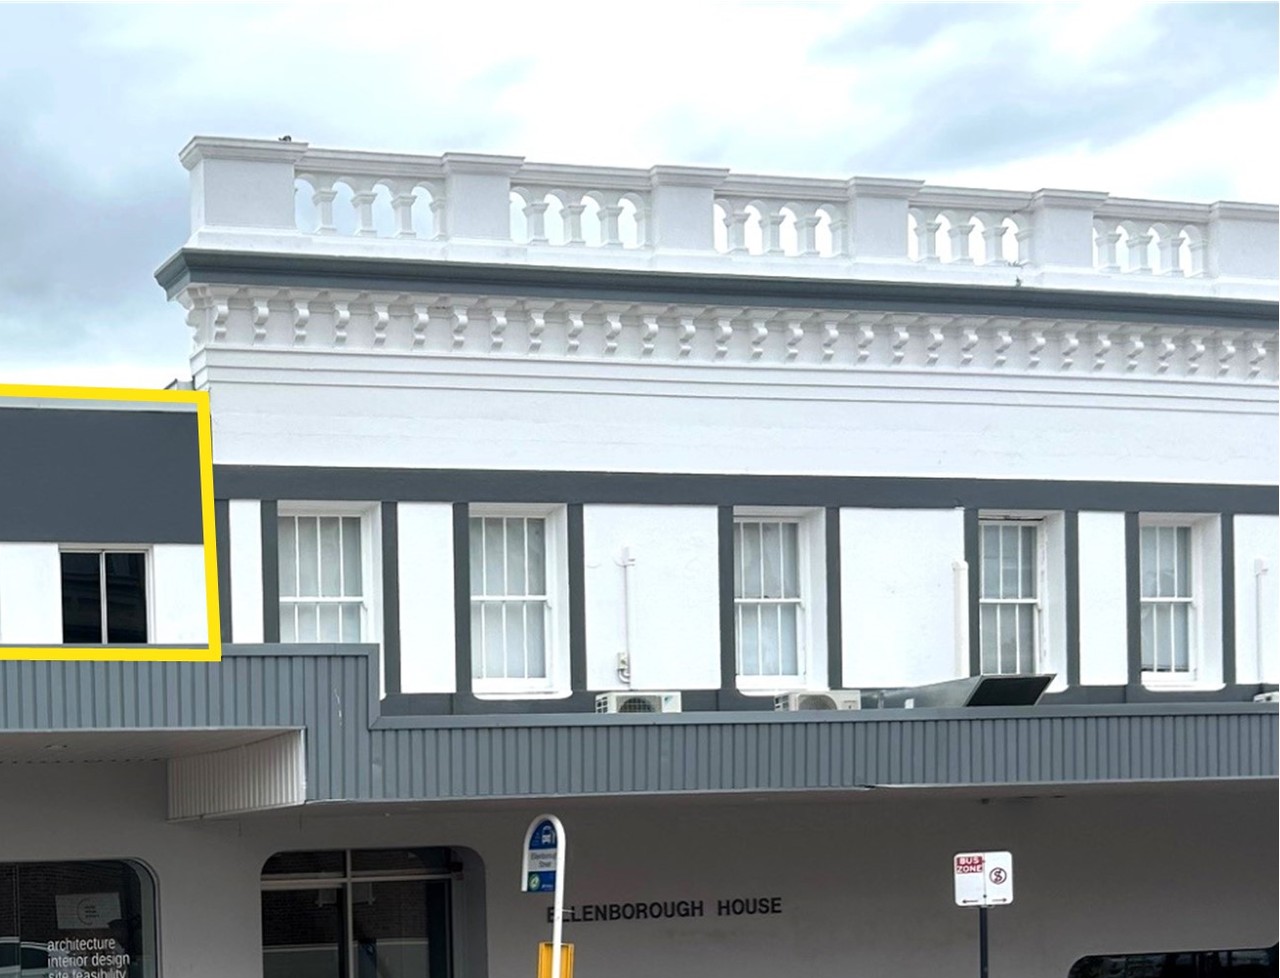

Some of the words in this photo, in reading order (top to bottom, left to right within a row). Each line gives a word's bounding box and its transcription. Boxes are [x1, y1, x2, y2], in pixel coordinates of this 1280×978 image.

[959, 857, 980, 865] BUS
[957, 865, 982, 873] ZONE
[718, 898, 782, 916] HOUSE
[47, 937, 116, 951] architecture
[47, 955, 89, 968] interior
[91, 953, 131, 969] design
